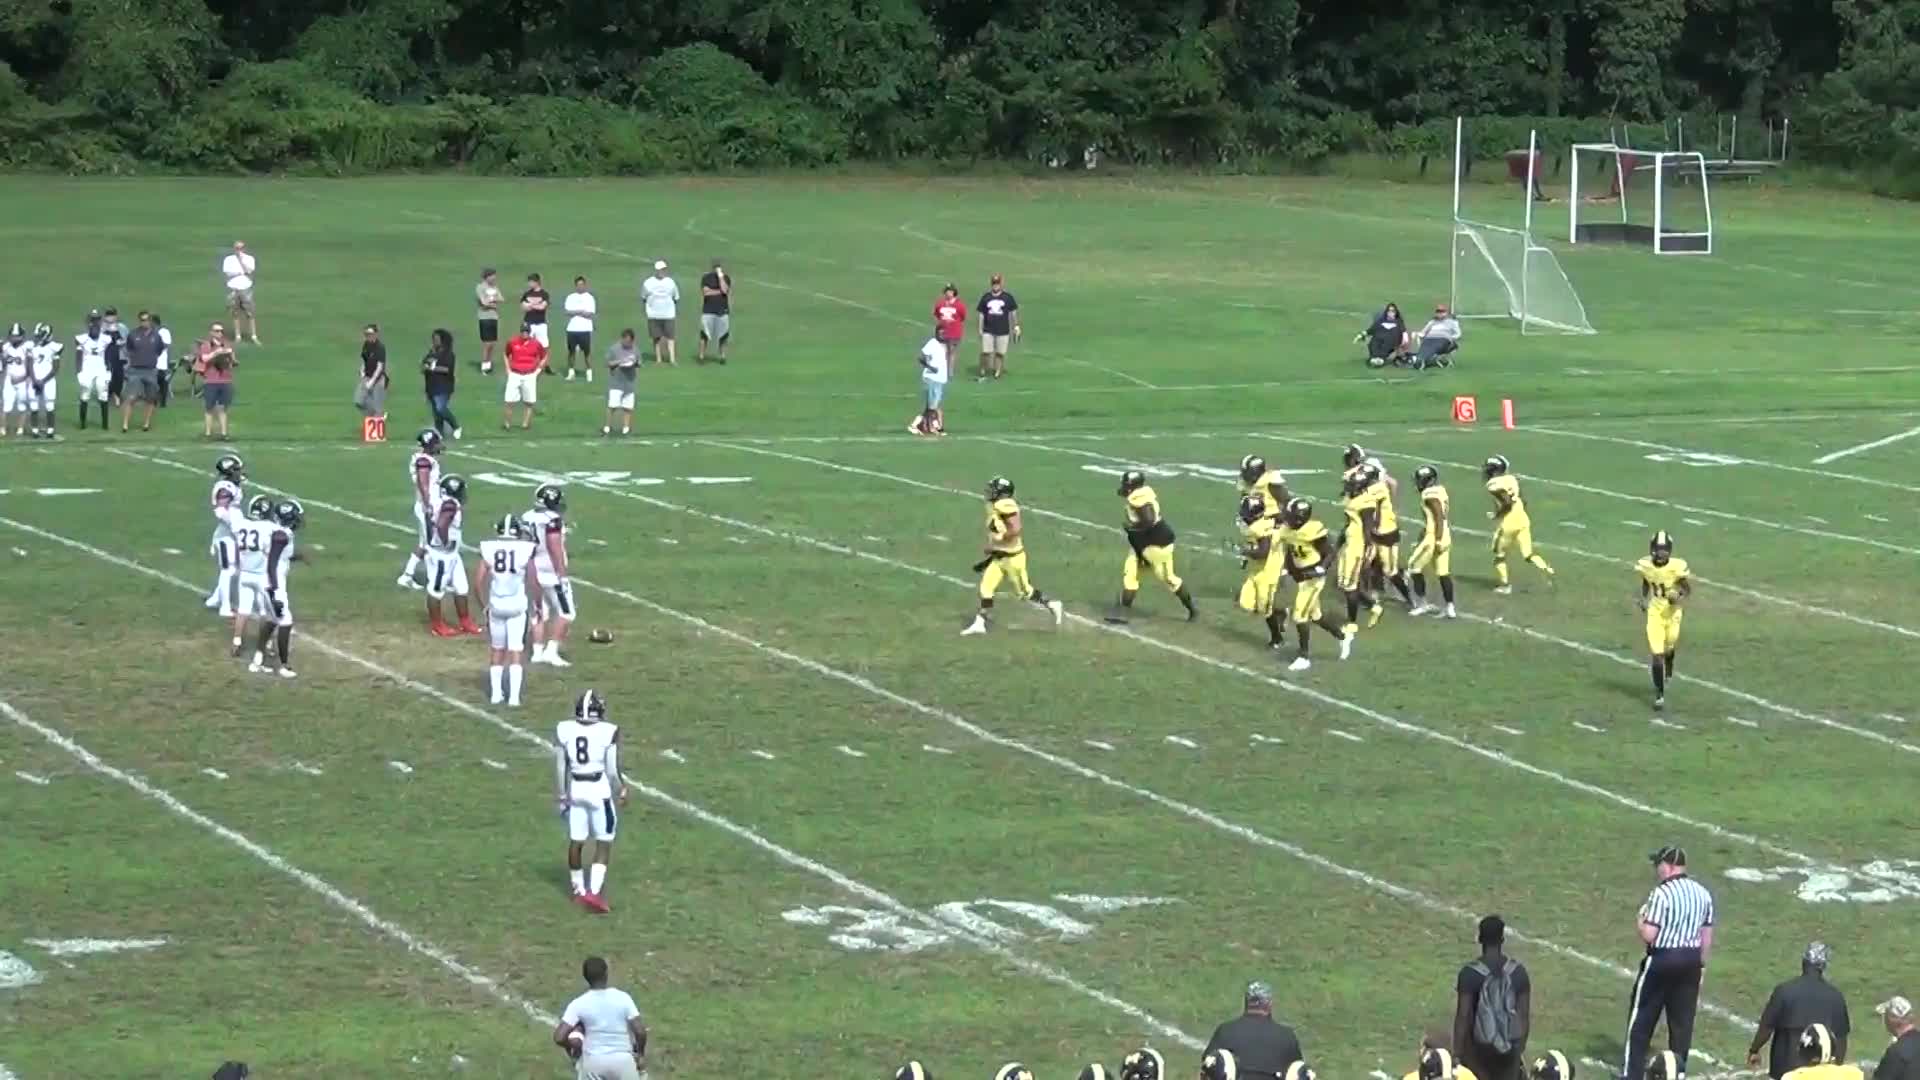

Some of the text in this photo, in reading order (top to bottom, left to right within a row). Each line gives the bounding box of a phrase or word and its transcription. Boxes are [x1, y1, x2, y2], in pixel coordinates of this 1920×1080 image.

[1458, 400, 1474, 420] G
[367, 419, 386, 441] 20
[238, 528, 260, 552] 33
[494, 549, 517, 574] 81
[576, 735, 590, 765] 8
